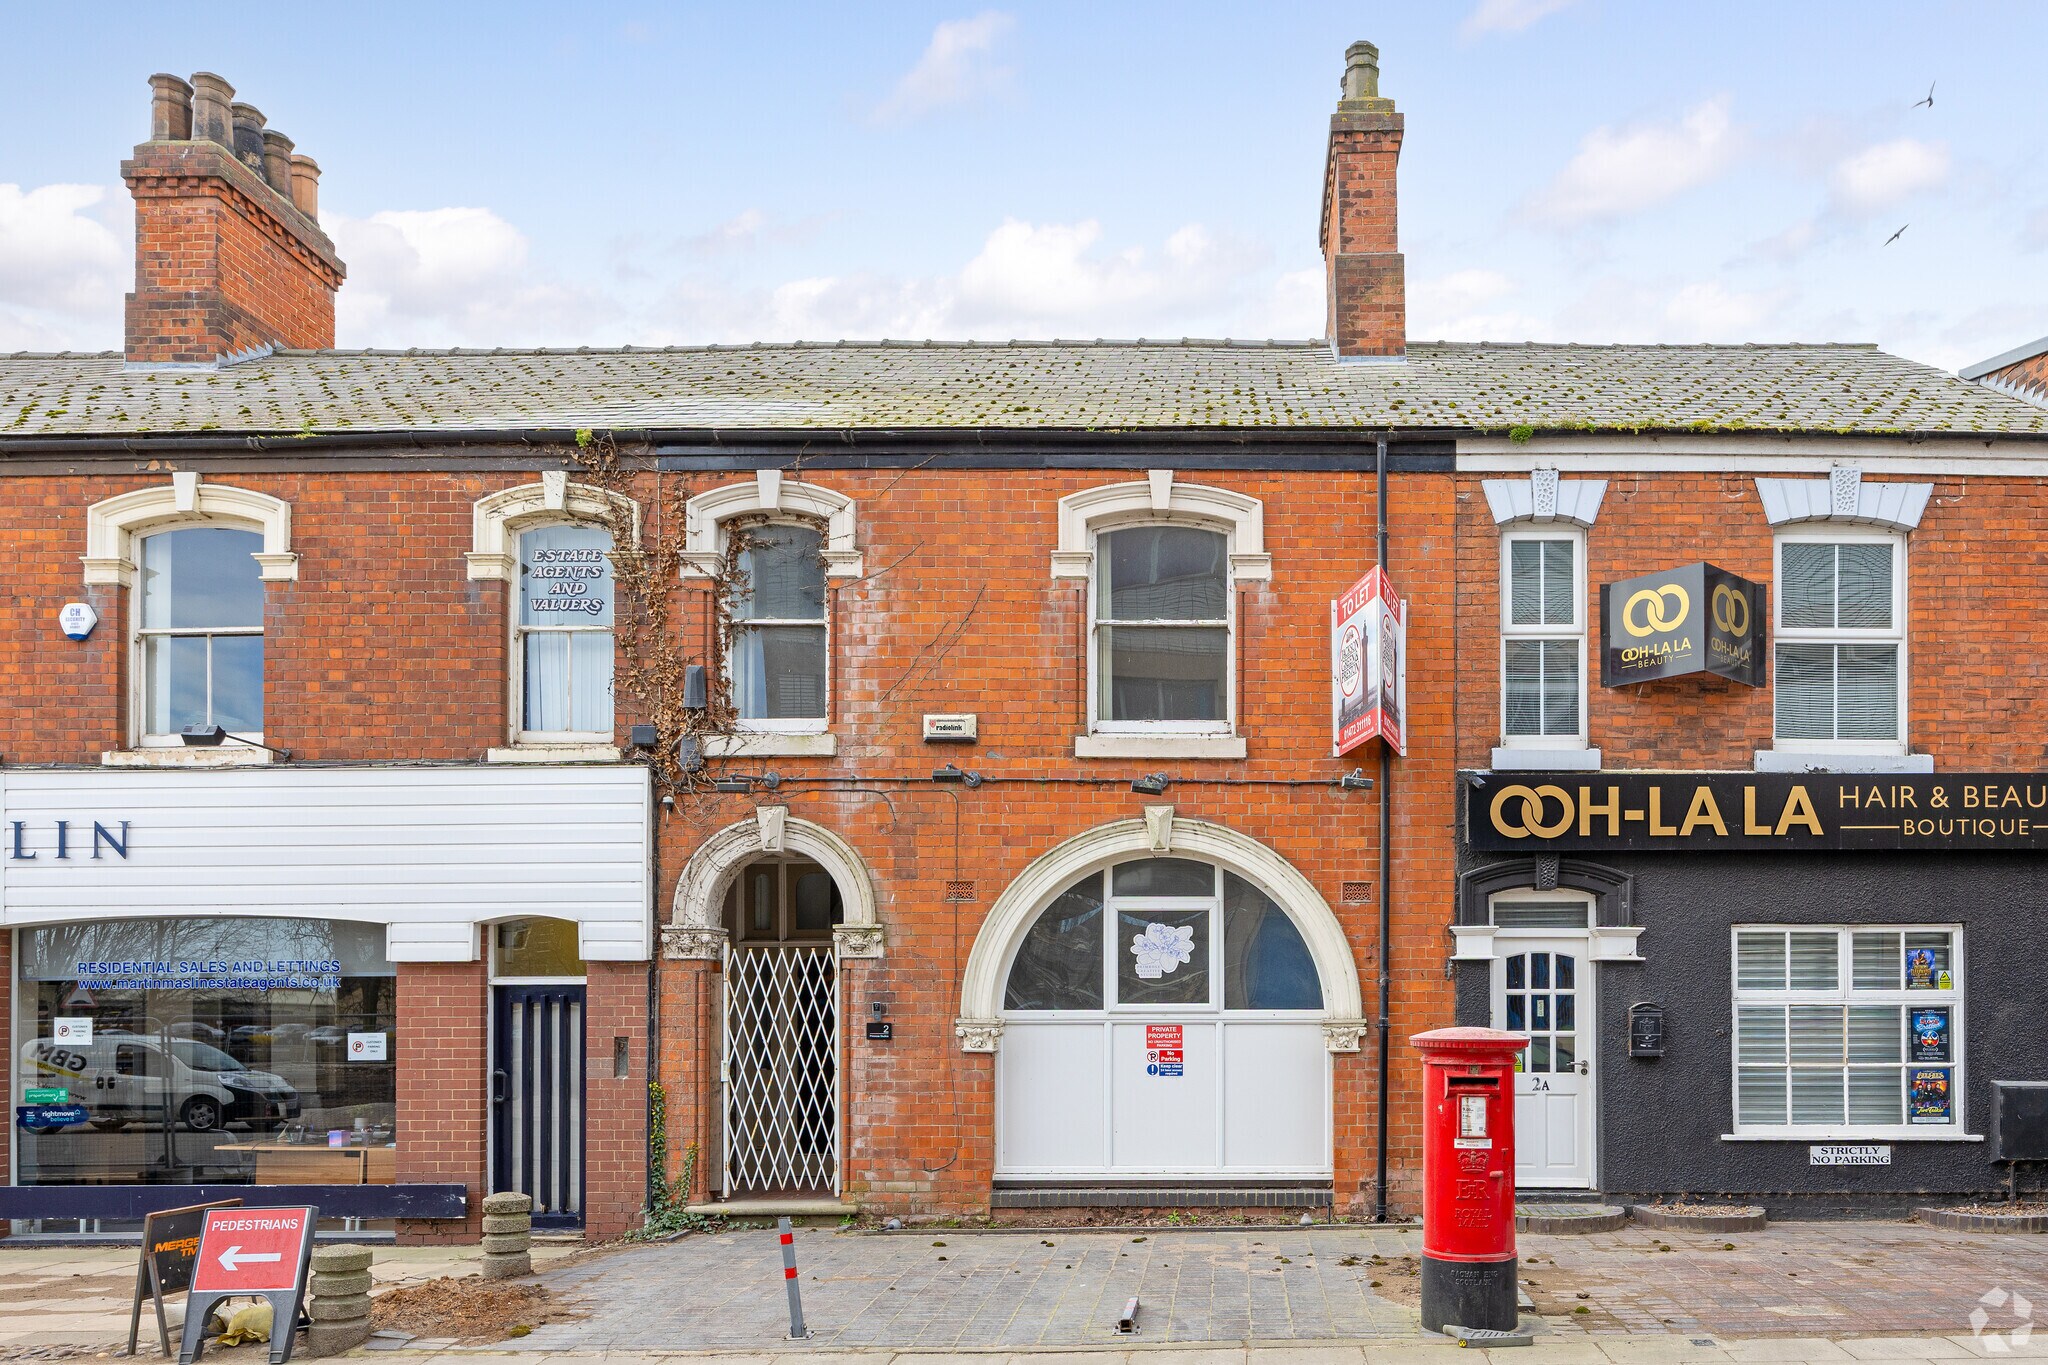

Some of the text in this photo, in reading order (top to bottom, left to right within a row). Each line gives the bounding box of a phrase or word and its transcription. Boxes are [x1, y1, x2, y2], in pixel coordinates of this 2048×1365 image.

[532, 549, 603, 563] ESTATE
[531, 566, 604, 581] AGENTS
[548, 582, 588, 597] AND
[531, 598, 605, 616] VALUERS
[1342, 598, 1354, 620] TO
[1355, 582, 1370, 610] LET
[70, 608, 81, 617] CH
[1621, 637, 1692, 662] OOH-LA LA
[1739, 649, 1750, 662] LA
[1637, 654, 1674, 669] BEAUTY
[1720, 654, 1741, 667] BEAUTY
[1489, 784, 1729, 839] OOH-LA
[1744, 785, 1824, 836] LA
[1839, 785, 1918, 808] HAIR
[1930, 786, 1949, 808] &
[1903, 819, 2029, 838] BOUTIQUE
[10, 820, 132, 860] LIN
[77, 960, 341, 975] RESIDENTIAL SALES AND LETTINGS
[78, 976, 342, 992] www.martinmaslinestateagents.co.uk
[883, 1025, 889, 1034] 2
[1532, 1077, 1550, 1091] 2A
[42, 1110, 75, 1119] rightmove
[1820, 1147, 1881, 1155] STRICTLY
[1812, 1156, 1890, 1164] NO PARKING
[1454, 1208, 1492, 1218] ROYAL
[211, 1218, 299, 1232] PEDESTRIANS
[1458, 1218, 1489, 1228] MAIL
